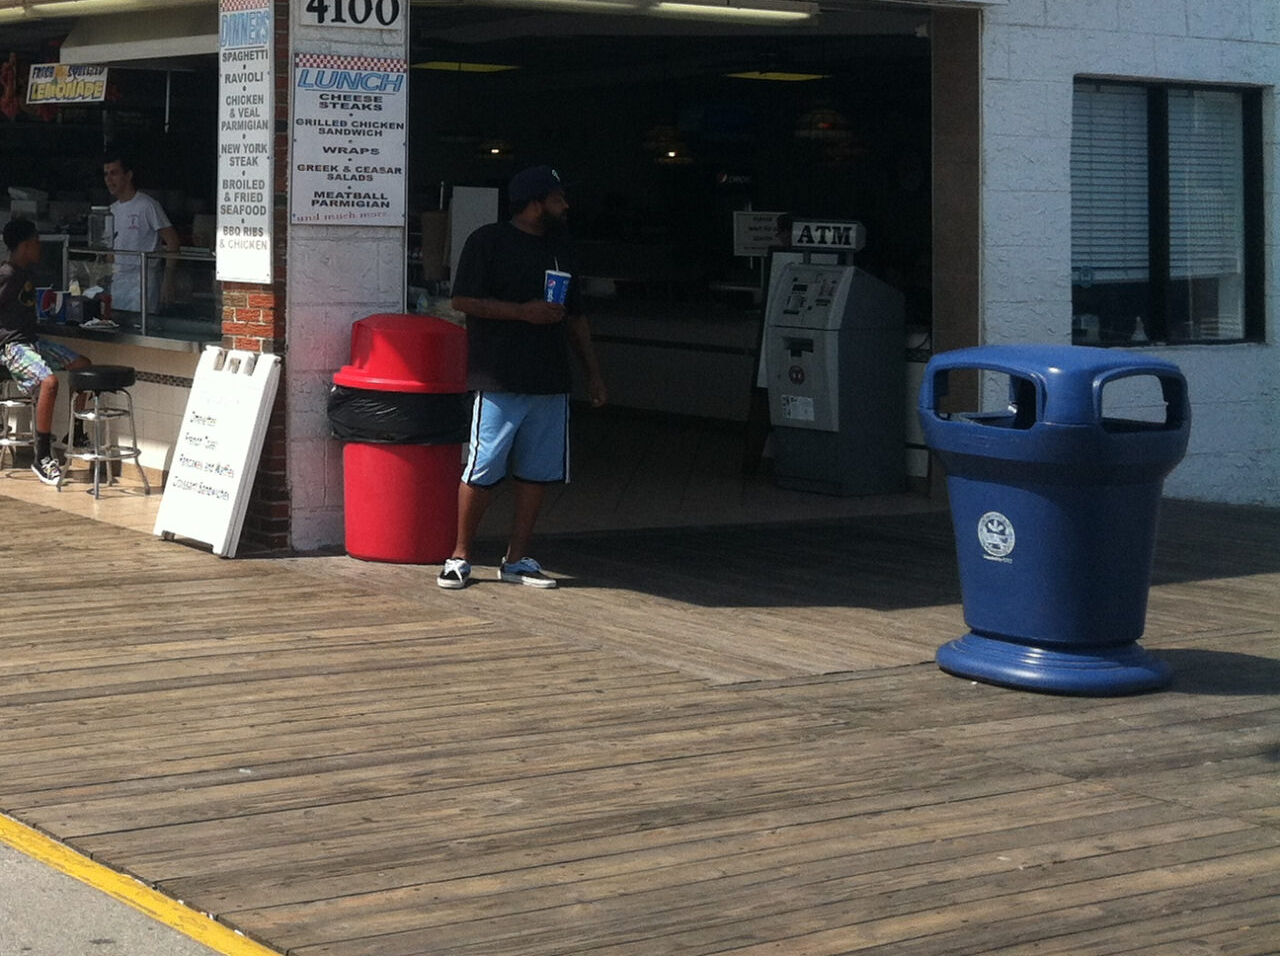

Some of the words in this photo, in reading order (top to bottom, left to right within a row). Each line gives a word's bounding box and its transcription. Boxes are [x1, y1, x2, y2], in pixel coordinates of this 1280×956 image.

[221, 10, 270, 48] DINNERS
[222, 49, 269, 62] SPAGHETTI
[224, 72, 264, 84] RAVIOLI
[297, 69, 407, 93] LUNCH
[30, 80, 105, 101] LEMONADE
[225, 94, 265, 107] CHICKEN
[318, 93, 384, 104] CHEESE
[229, 108, 236, 119] &
[238, 106, 261, 118] VEAL
[318, 102, 384, 112] STEAKS
[221, 120, 269, 132] PARMIGIAN
[295, 118, 348, 128] GRILLED
[351, 120, 405, 131] CHICKEN
[318, 127, 384, 138] SANDWICH
[221, 144, 241, 155] NEW
[242, 143, 268, 155] YORK
[322, 146, 381, 156] WRAPS
[229, 156, 259, 167] STEAK
[296, 164, 339, 173] GREEK
[342, 165, 351, 173] &
[354, 165, 403, 175] CEASAR
[326, 173, 374, 182] SALADS
[222, 179, 266, 191] BROILED
[224, 192, 232, 203] &
[234, 191, 264, 204] FRIED
[313, 190, 389, 200] MEATBALL
[311, 198, 390, 209] PARMIGIAN
[220, 204, 267, 217] SEAFOOD
[296, 211, 320, 222] and
[323, 211, 357, 221] much
[222, 225, 242, 237] BBQ
[243, 226, 265, 237] RIBS
[797, 224, 853, 246] ATM
[227, 239, 268, 251] CHICKEN
